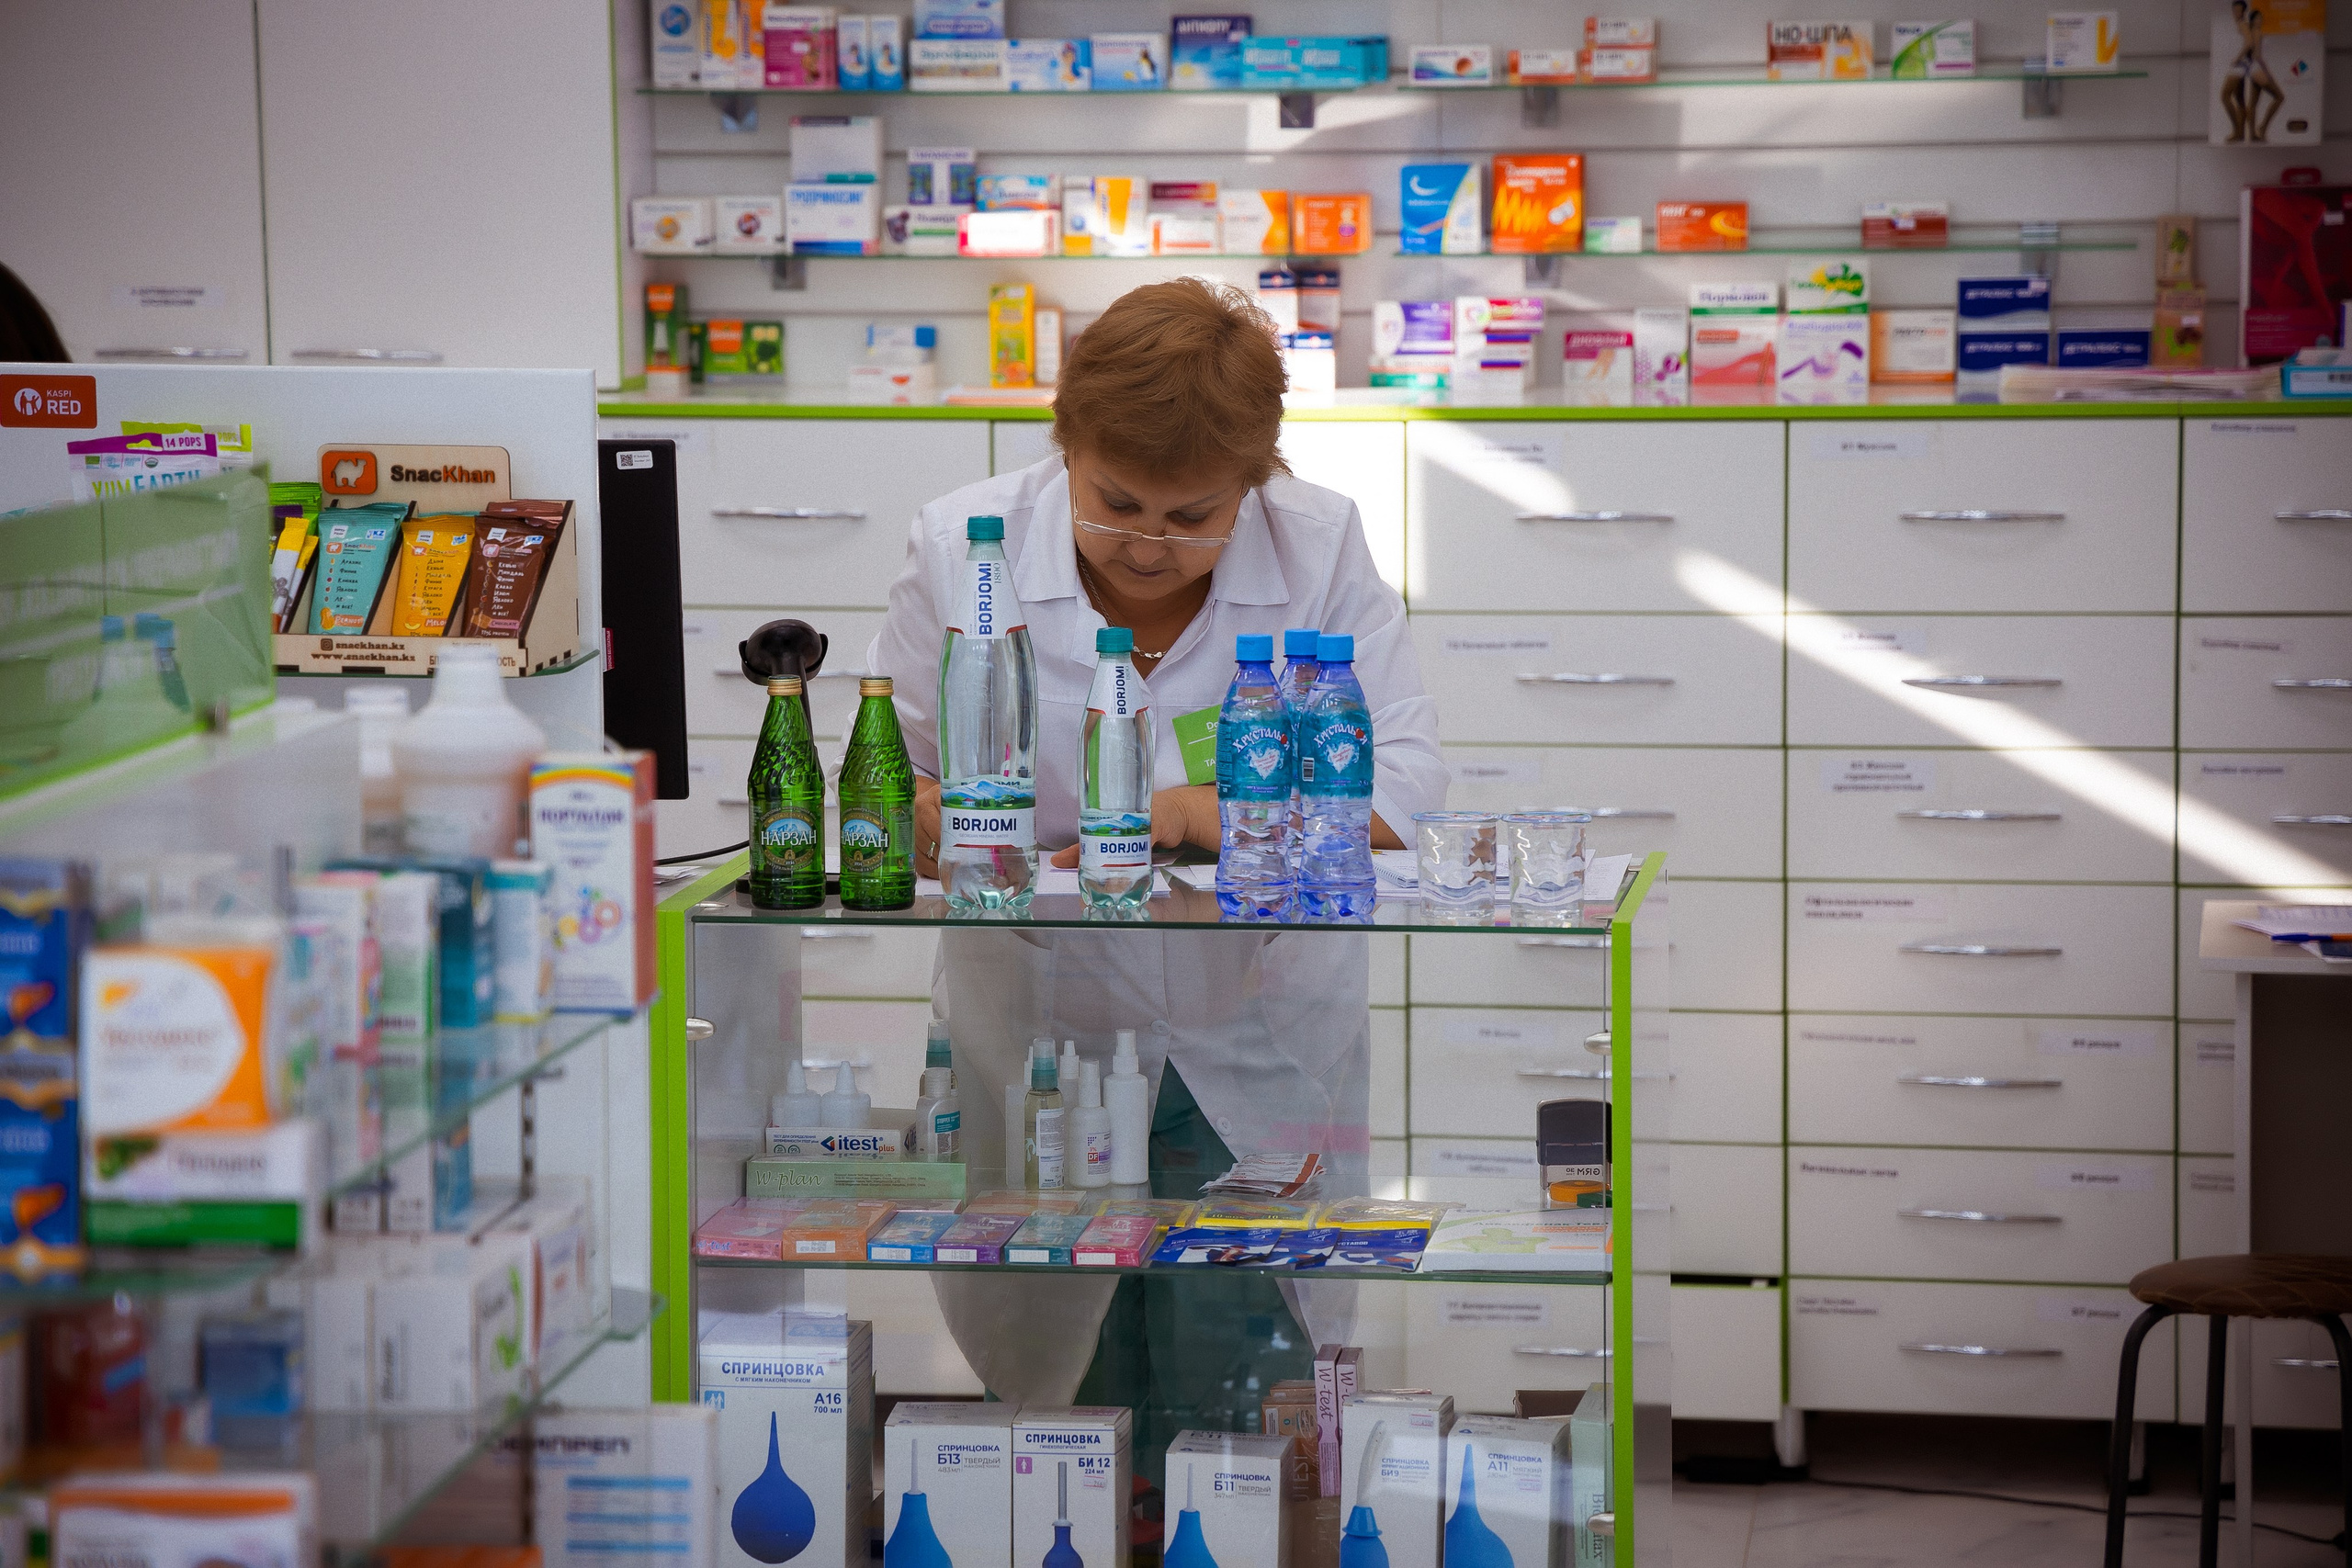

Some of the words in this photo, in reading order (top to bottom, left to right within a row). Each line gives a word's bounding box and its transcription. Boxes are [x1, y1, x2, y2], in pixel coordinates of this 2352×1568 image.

[47, 400, 82, 415] RED
[165, 438, 175, 448] 14
[178, 436, 202, 447] POPS
[218, 432, 238, 443] POPS
[390, 465, 495, 483] SnacKhan
[993, 563, 1001, 583] 1890
[978, 563, 992, 635] BORJOMI
[335, 641, 405, 651] snackhan.kz
[311, 652, 416, 662] www.snackhan.kz
[1115, 666, 1126, 715] BORJOMI
[953, 817, 1016, 831] BORJOMI
[761, 829, 817, 846] НАРЗАН
[1101, 841, 1148, 853] BORJOMI
[838, 1134, 878, 1151] itest
[878, 1145, 895, 1154] plus
[756, 1170, 823, 1191] W-plan
[722, 1361, 824, 1377] СПРИНЦОВКА
[814, 1393, 842, 1404] А16
[1318, 1367, 1334, 1421] W-test
[1025, 1434, 1101, 1445] СПРИНЦОВКА
[938, 1453, 961, 1464] Б13
[1079, 1458, 1093, 1468] БИ
[1097, 1458, 1110, 1468] 12
[1382, 1458, 1430, 1466] СПРИНЦОВКА
[1487, 1453, 1543, 1463] СПРИНЦОВКА
[1487, 1461, 1509, 1472] А11
[1215, 1473, 1272, 1482] СПРИНЦОВКА
[1214, 1481, 1234, 1492] Б11
